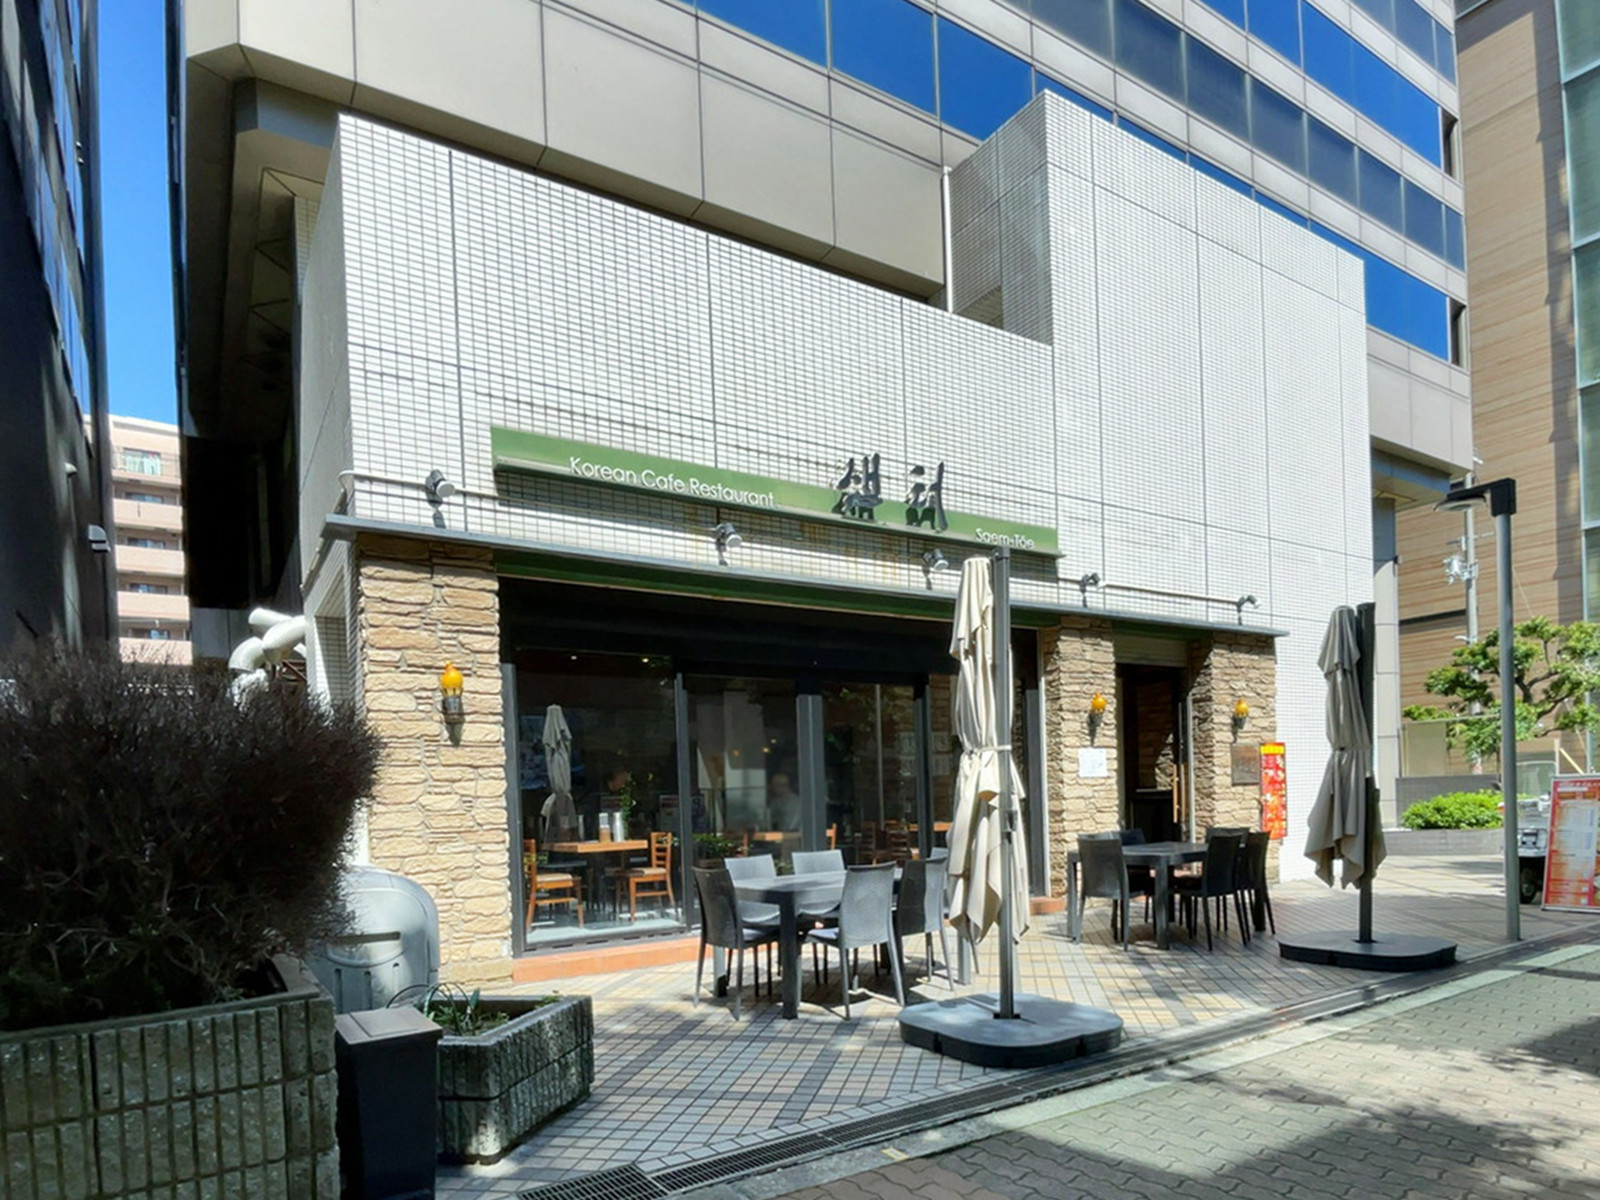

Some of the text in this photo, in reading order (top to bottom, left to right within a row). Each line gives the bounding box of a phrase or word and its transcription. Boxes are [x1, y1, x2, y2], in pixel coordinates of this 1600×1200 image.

[569, 456, 775, 508] Korean Cafe Restaurant
